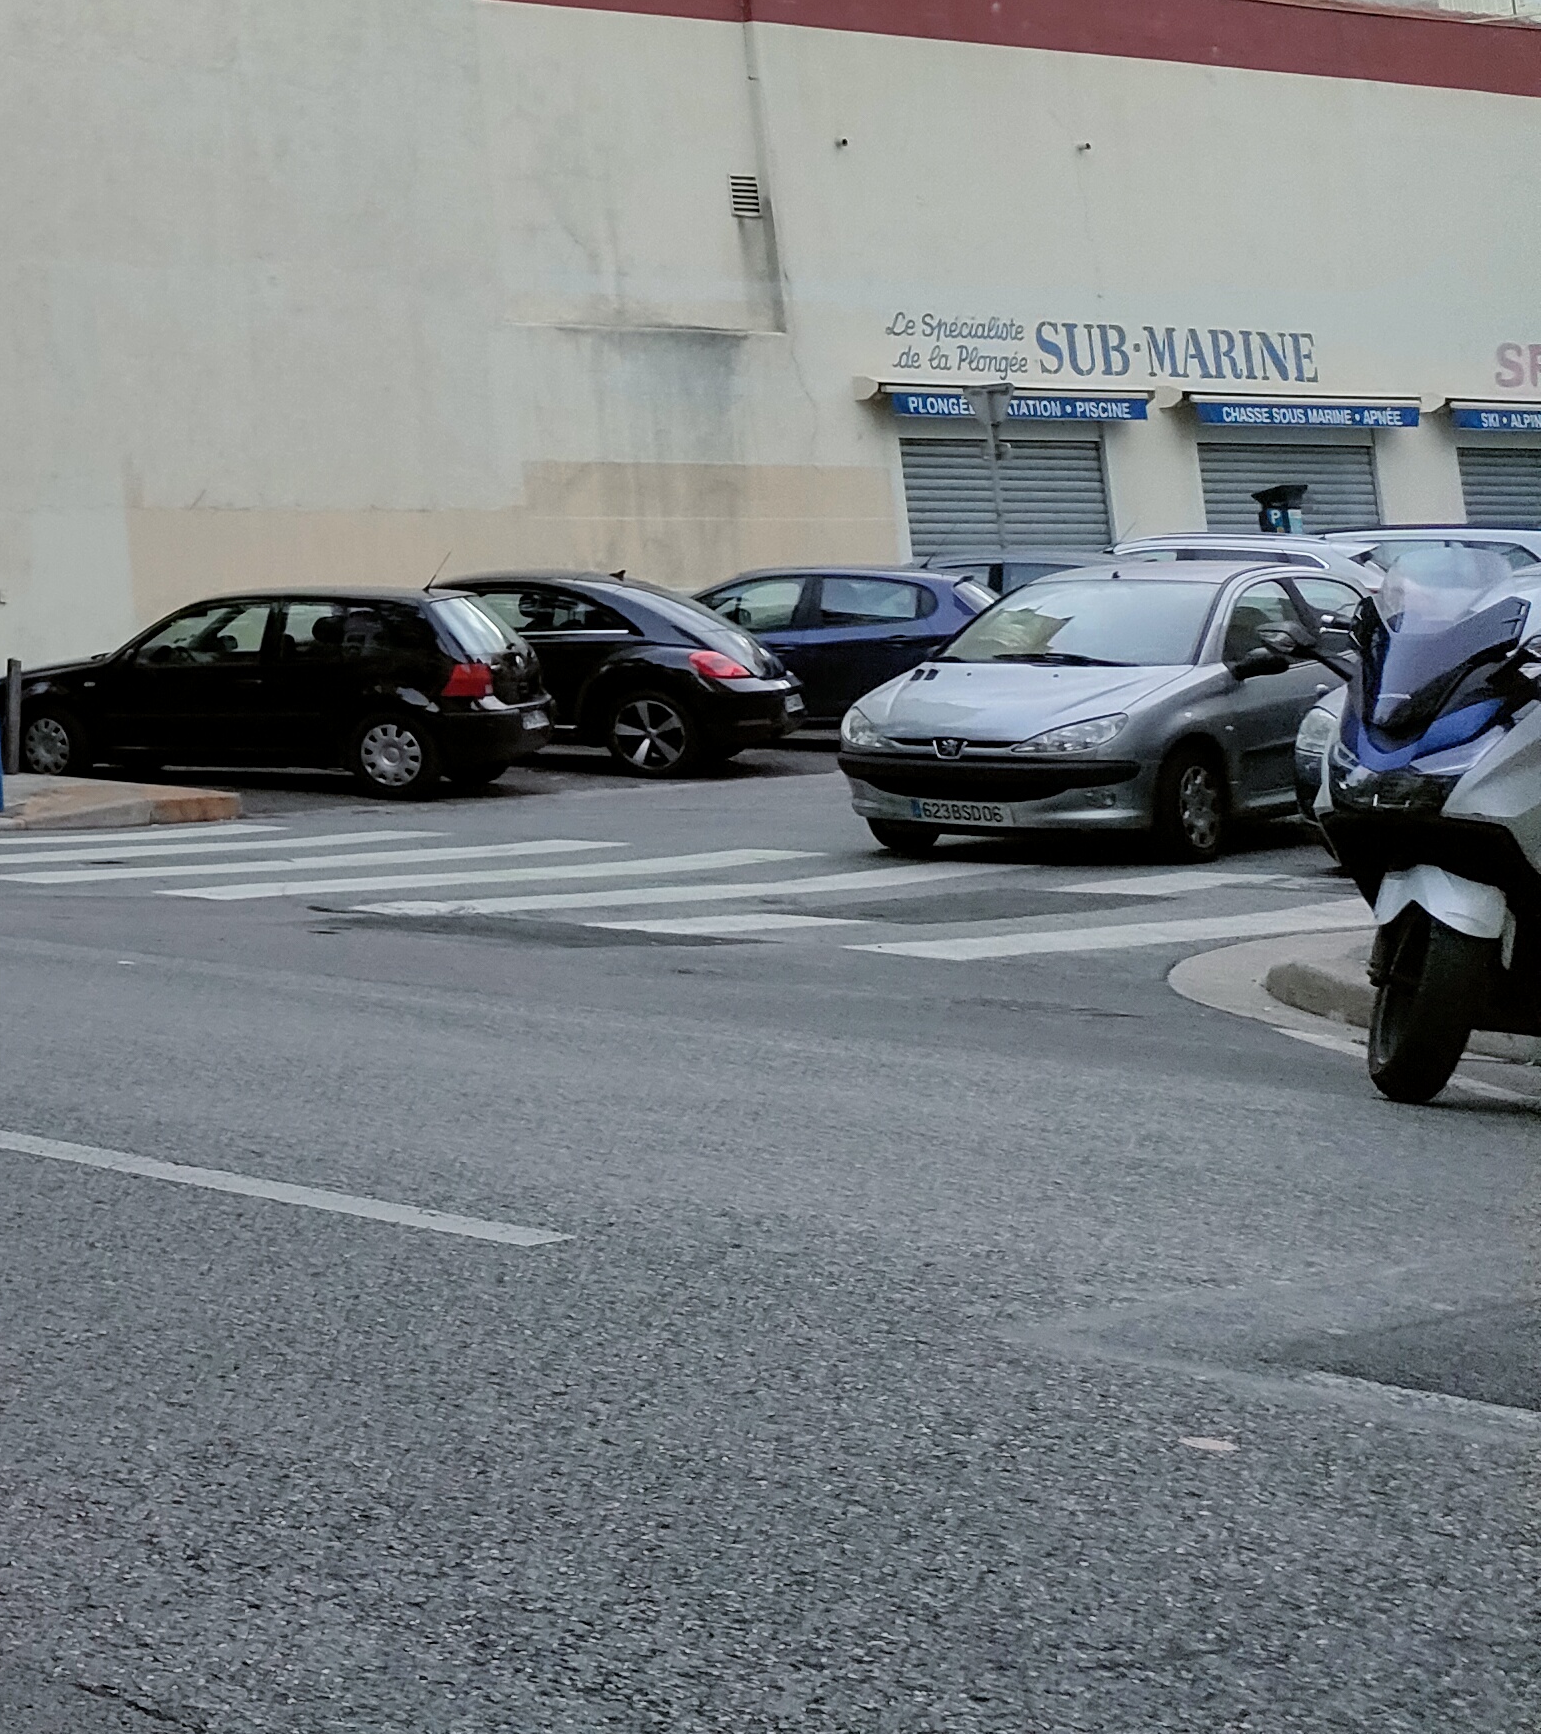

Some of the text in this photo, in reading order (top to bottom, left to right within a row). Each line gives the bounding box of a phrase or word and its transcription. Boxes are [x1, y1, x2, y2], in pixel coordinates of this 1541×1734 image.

[885, 311, 1025, 342] Le Spécialiste
[892, 344, 1029, 381] de la Plongée
[1076, 401, 1132, 419] PISCINE
[1222, 406, 1271, 423] CHASSE
[1272, 407, 1306, 424] SOUS
[1307, 409, 1353, 425] MARINE
[1480, 412, 1500, 428] SKI
